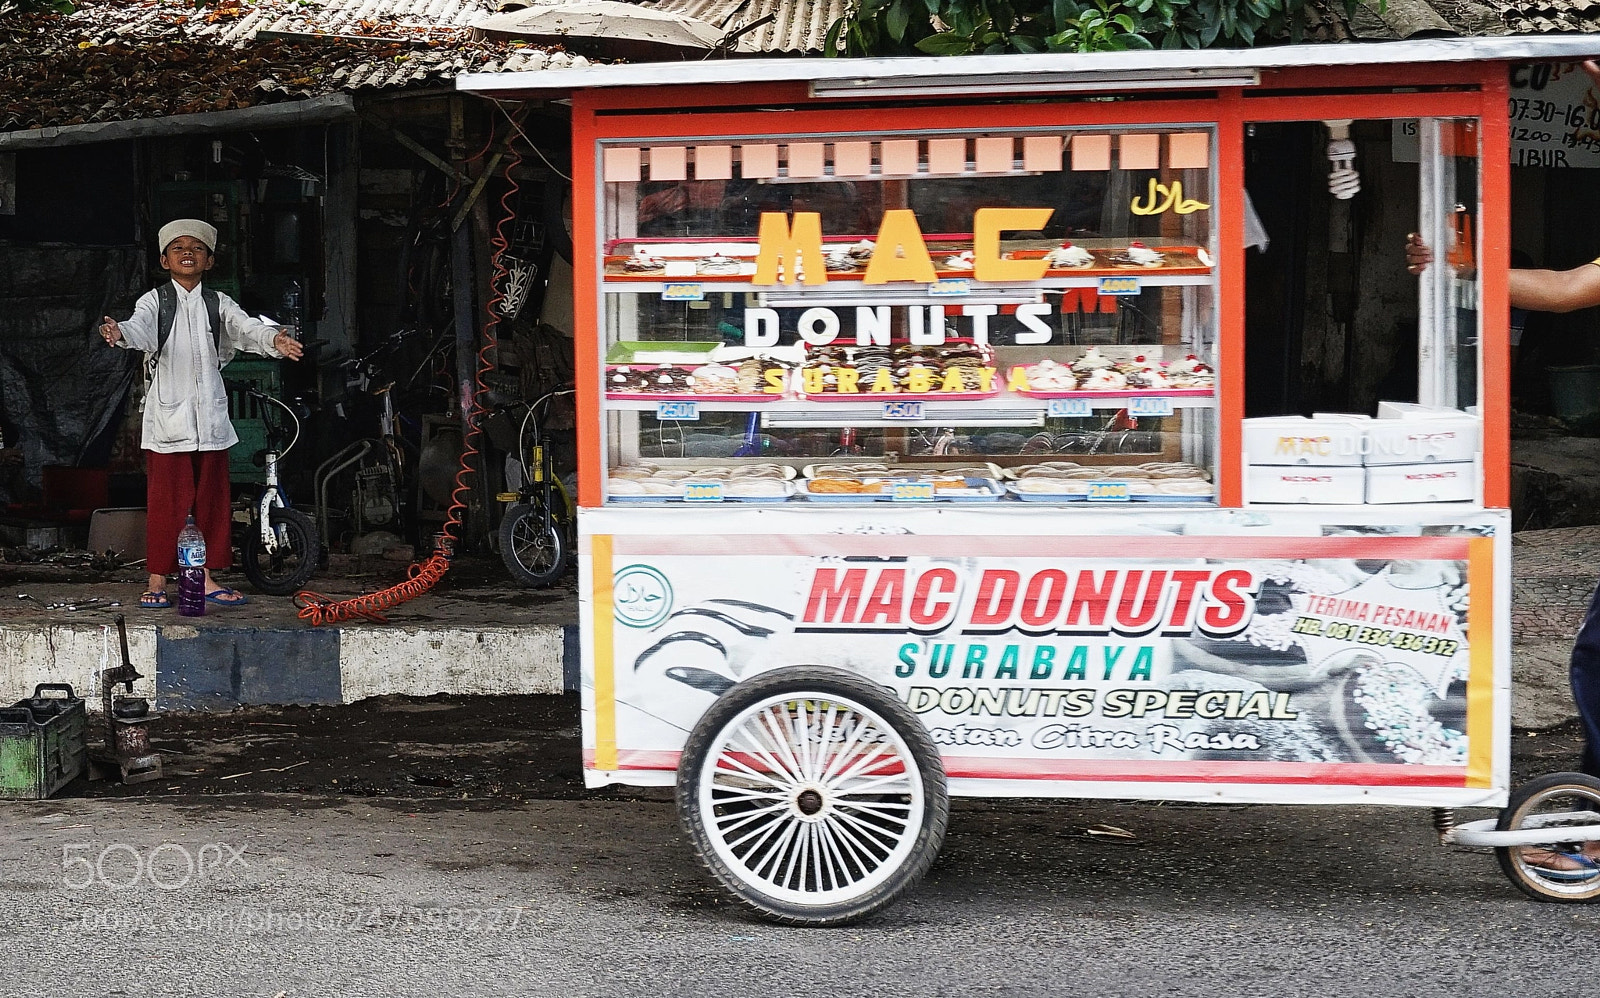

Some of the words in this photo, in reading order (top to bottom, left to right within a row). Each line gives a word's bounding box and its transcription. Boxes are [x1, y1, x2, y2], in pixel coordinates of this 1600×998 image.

[1131, 177, 1211, 215] حلال
[752, 207, 1055, 285] MAC
[745, 303, 1053, 346] DONUTS
[764, 366, 1031, 394] SURABAYA
[884, 402, 922, 417] 2500
[1274, 435, 1331, 456] MAC
[1337, 433, 1447, 456] DONUTS
[800, 567, 959, 627] MAC
[968, 569, 1256, 630] DONUTS
[1306, 594, 1370, 622] TERIMA
[1371, 604, 1453, 634] PESANAN
[1325, 621, 1358, 641] 081
[1357, 626, 1392, 646] 336
[1389, 632, 1425, 651] 436
[1423, 637, 1459, 657] 312
[894, 643, 1155, 681] SURABAYA
[906, 686, 1096, 717] DONUTS
[1101, 689, 1299, 721] SPECIAL
[1032, 723, 1141, 750] Citra
[1146, 723, 1263, 754] Rasa
